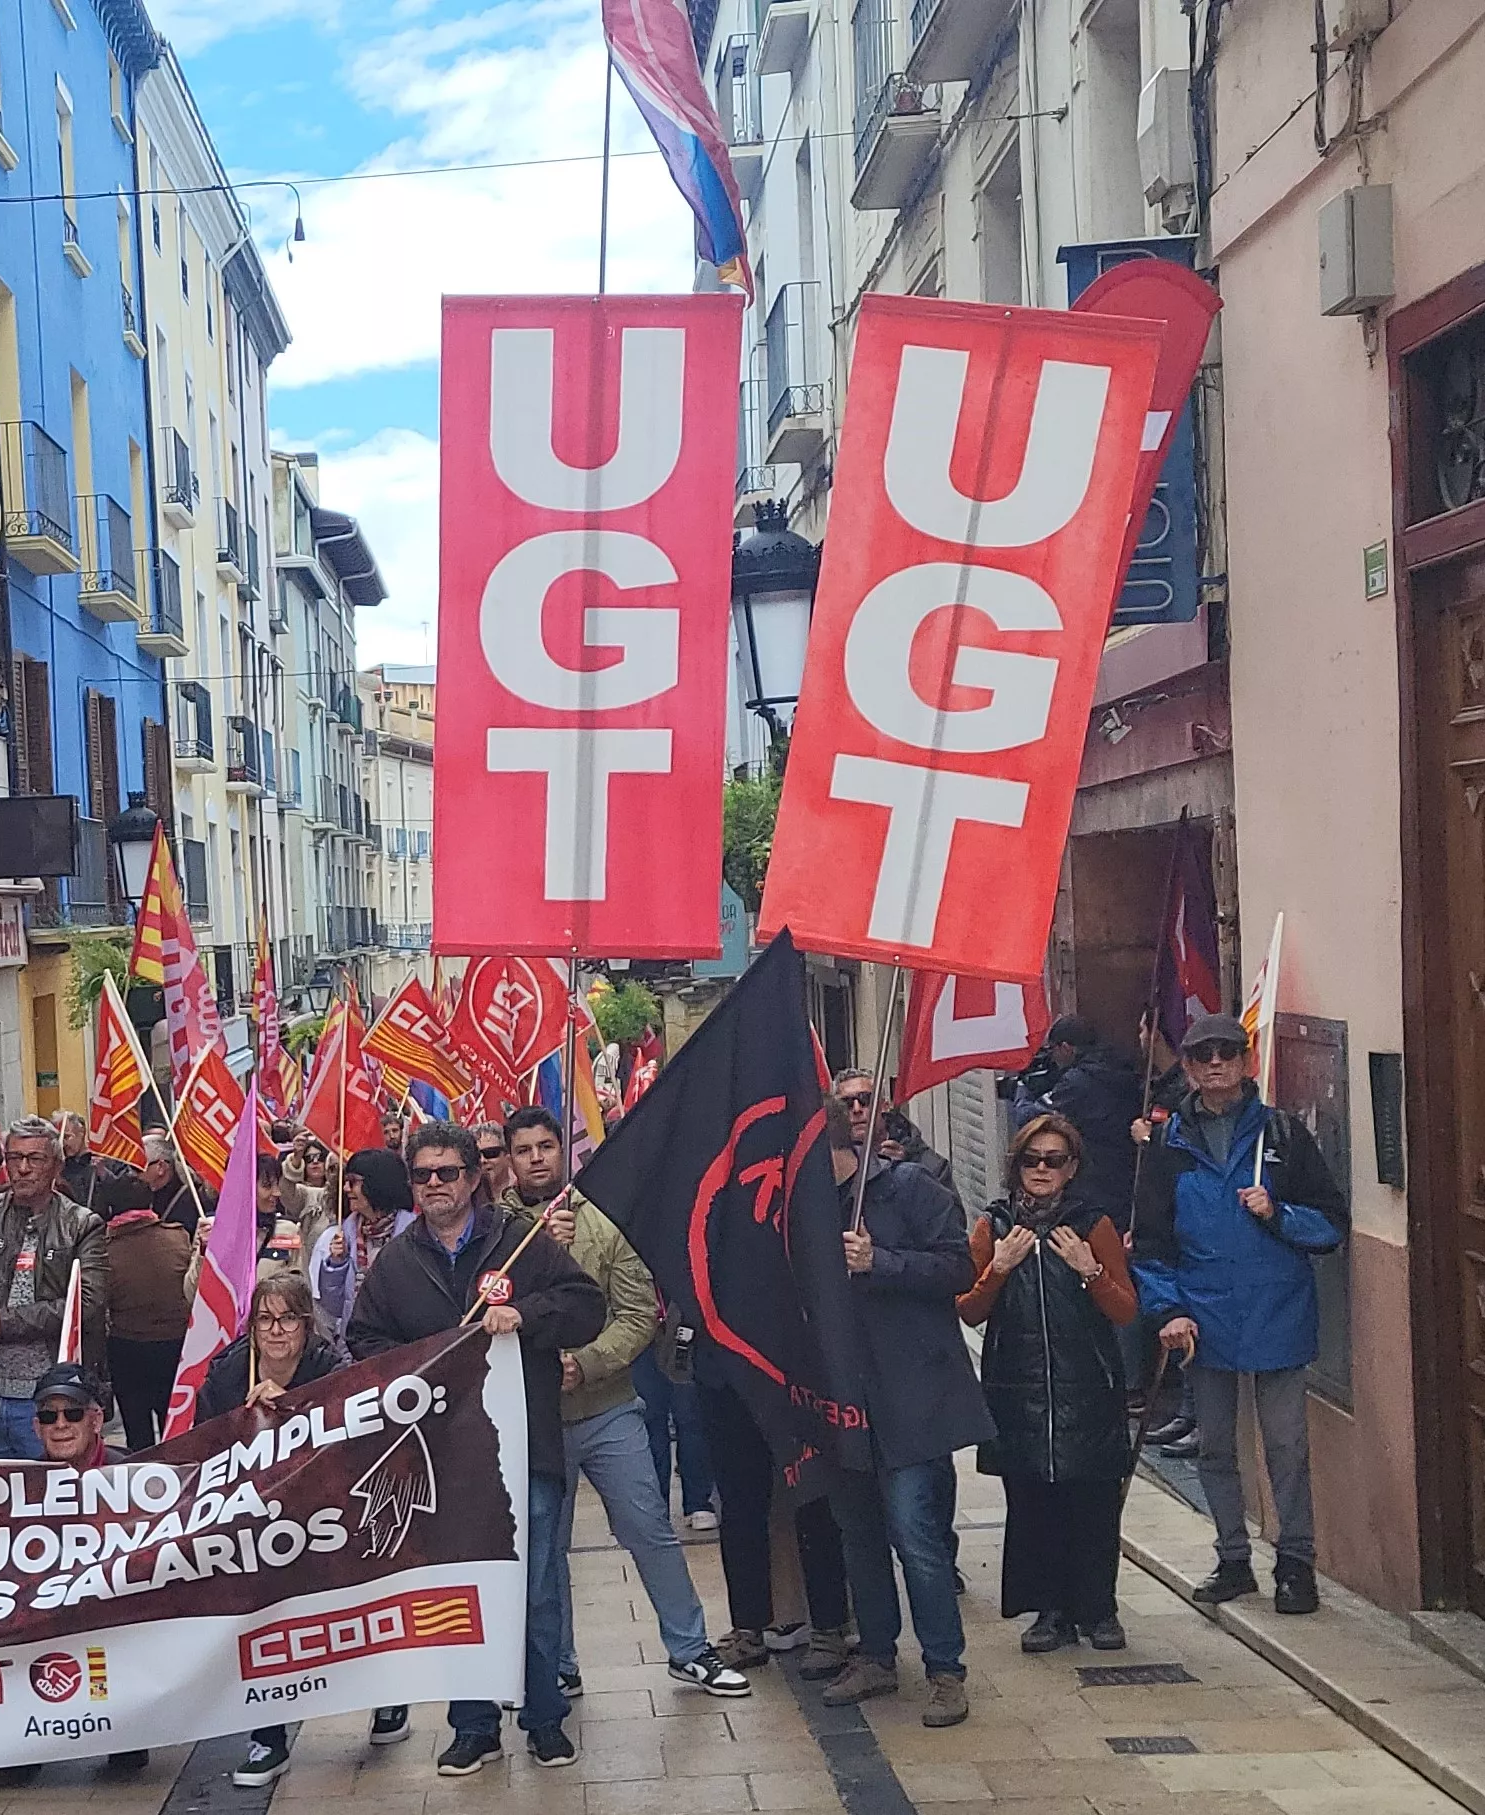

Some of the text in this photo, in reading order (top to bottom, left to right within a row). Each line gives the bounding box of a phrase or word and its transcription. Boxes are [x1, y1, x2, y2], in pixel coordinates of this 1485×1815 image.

[479, 328, 686, 901] UGT
[829, 344, 1112, 948] UGT
[197, 1374, 448, 1497] EMPLEO:
[29, 1507, 348, 1611] SALARIOS
[250, 1605, 406, 1668] CCOO
[24, 1712, 112, 1740] Aragón
[245, 1674, 328, 1705] Aragón
